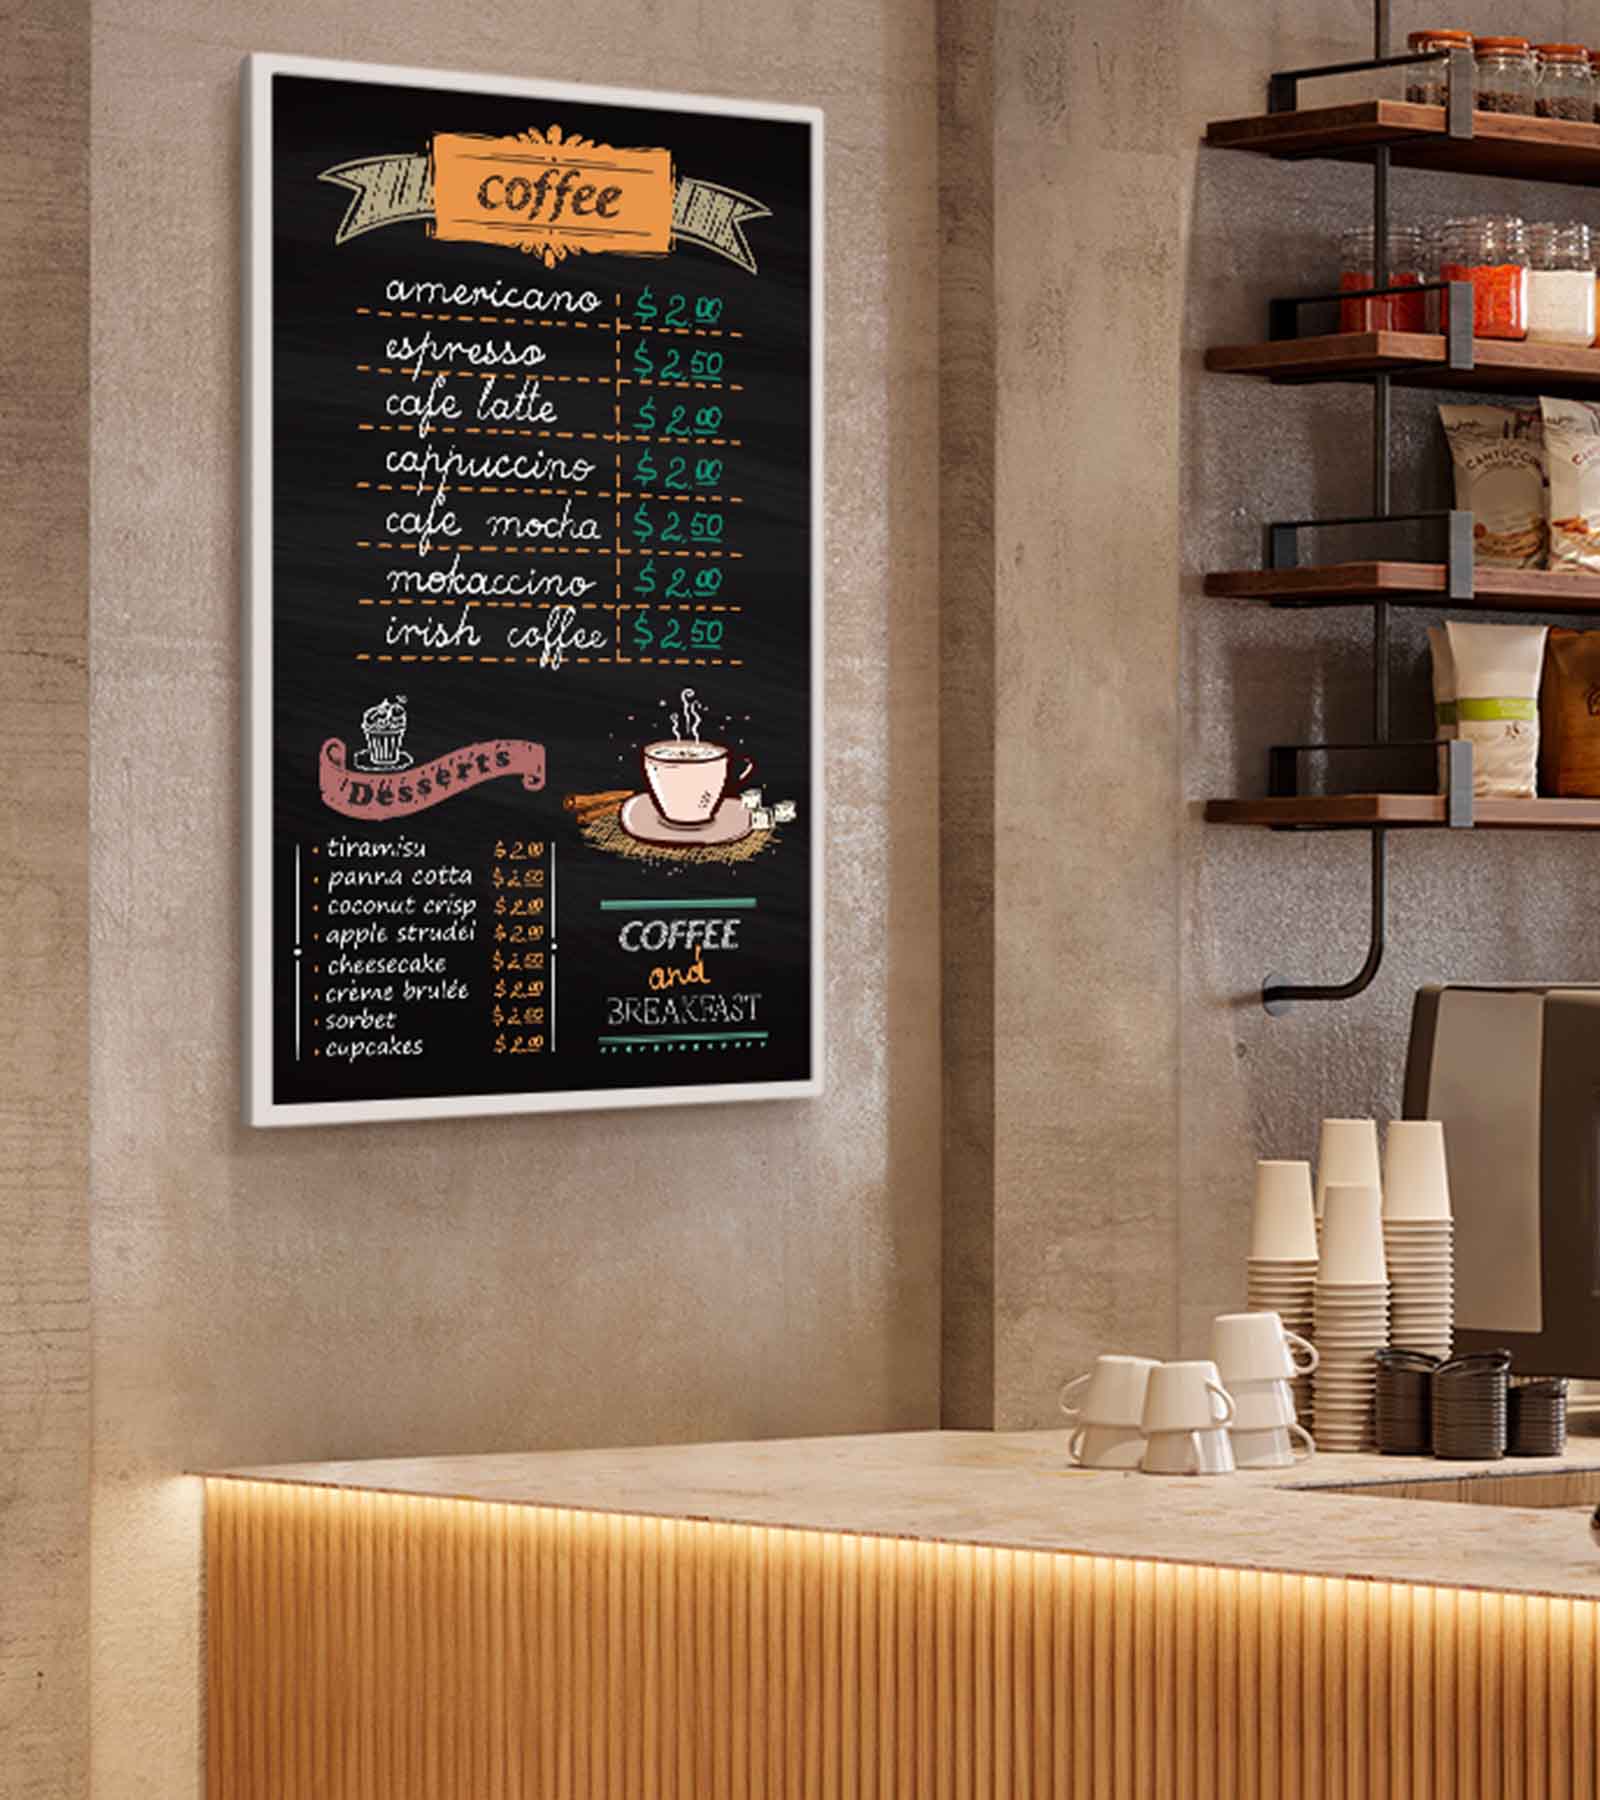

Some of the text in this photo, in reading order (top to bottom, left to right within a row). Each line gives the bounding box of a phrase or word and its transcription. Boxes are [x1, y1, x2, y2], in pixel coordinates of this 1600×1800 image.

[476, 168, 623, 222] coffee
[386, 279, 602, 314] americano
[386, 331, 547, 382] espresso
[386, 374, 463, 438] cafe
[477, 376, 558, 423] latte
[386, 445, 597, 497] cappuccino
[386, 494, 463, 556] cafe
[487, 499, 602, 540] mocha
[386, 553, 597, 597] mokaccino
[386, 604, 481, 649] irish
[507, 604, 608, 670] coffee
[347, 749, 511, 807] Desserts
[327, 835, 427, 859] tiramisu
[327, 868, 404, 894] panna
[411, 866, 473, 886] cotta
[327, 896, 417, 916] coconut
[423, 894, 477, 927] crisp
[325, 921, 389, 951] apple
[617, 918, 742, 952] COFFEE
[327, 952, 447, 976] cheesecake
[648, 944, 712, 991] and
[325, 1006, 397, 1031] sorbet
[607, 993, 762, 1026] BREAKFAST
[325, 1032, 424, 1065] cupcakes
